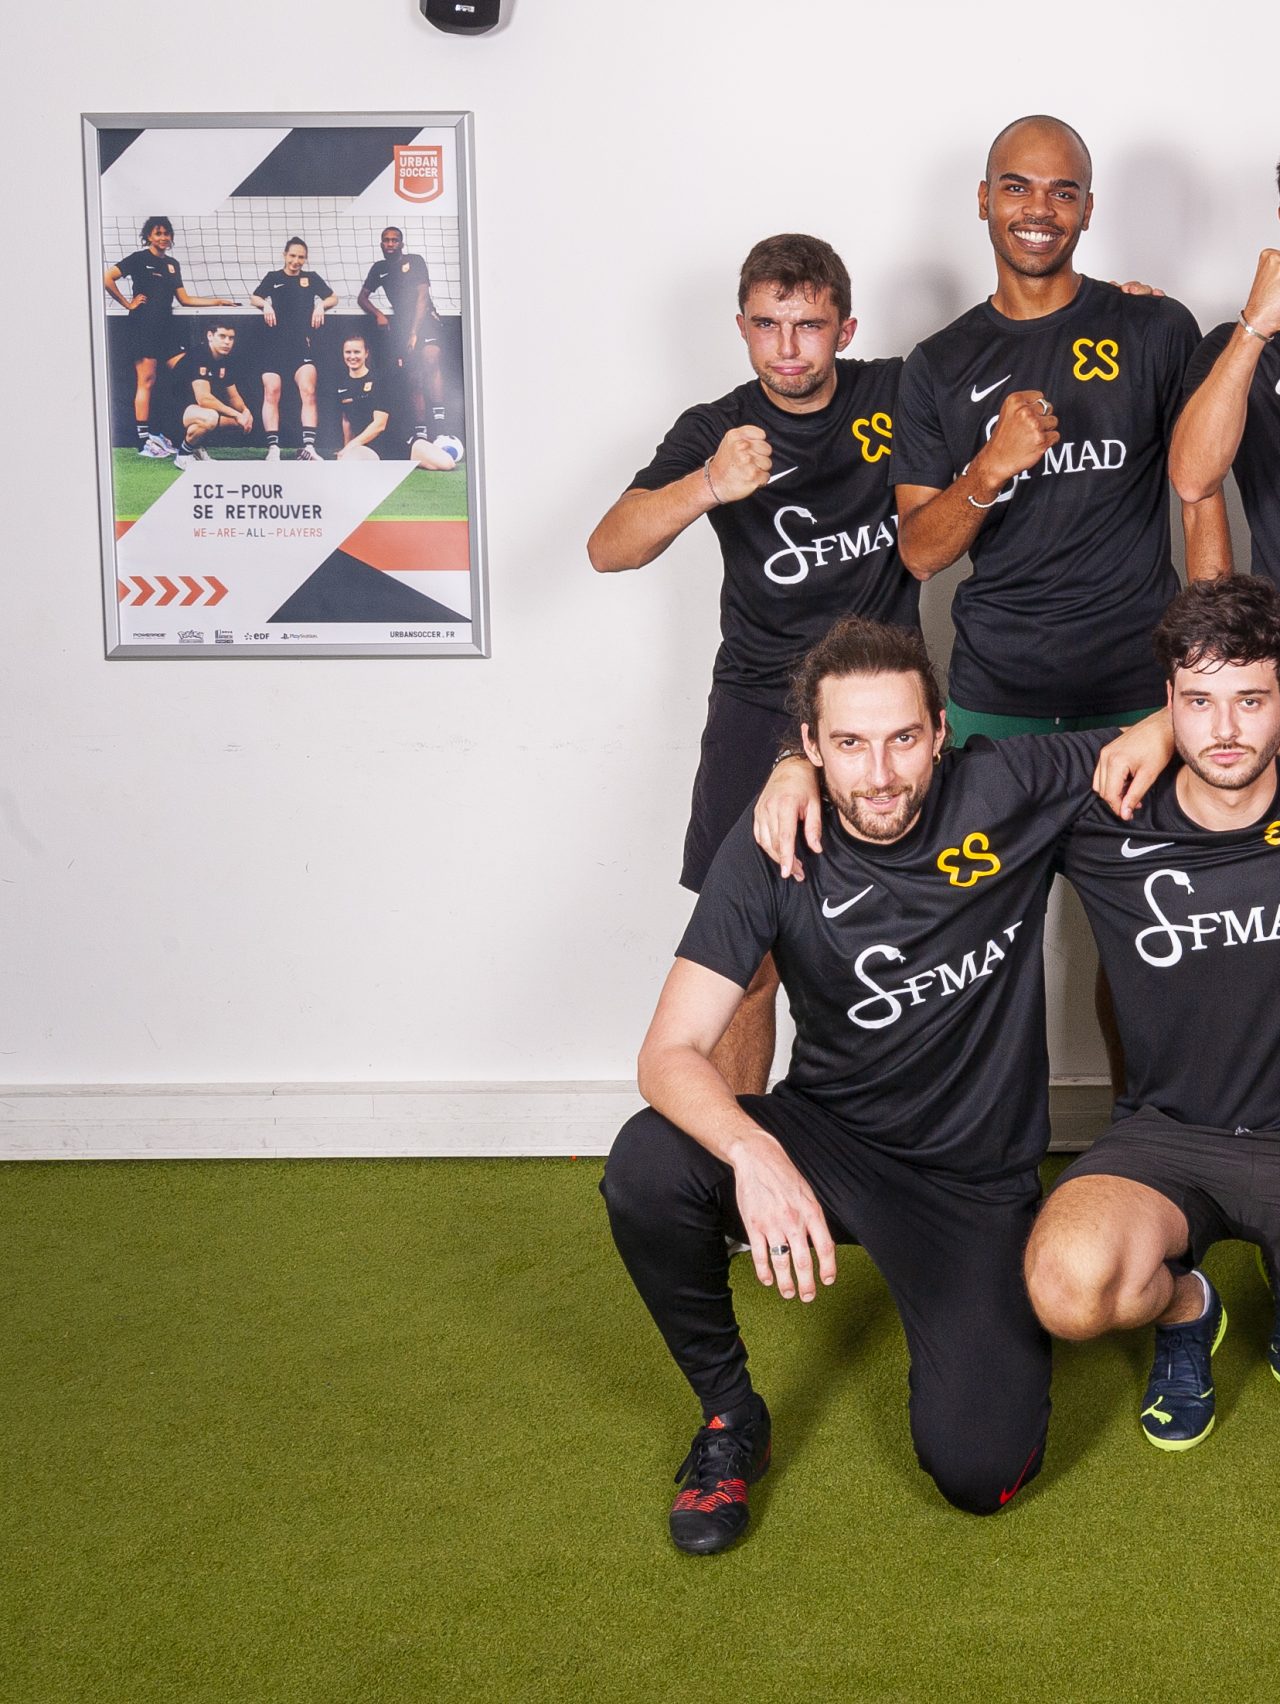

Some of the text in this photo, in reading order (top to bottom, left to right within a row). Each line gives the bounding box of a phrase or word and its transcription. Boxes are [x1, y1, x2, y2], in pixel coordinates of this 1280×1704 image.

[399, 156, 438, 168] URBAN
[399, 167, 438, 178] SOCCER
[193, 504, 322, 519] SE RETROUVER
[764, 505, 899, 585] SFMA
[389, 630, 455, 638] URBANSOCCER.FR
[847, 921, 1023, 1029] SFMA
